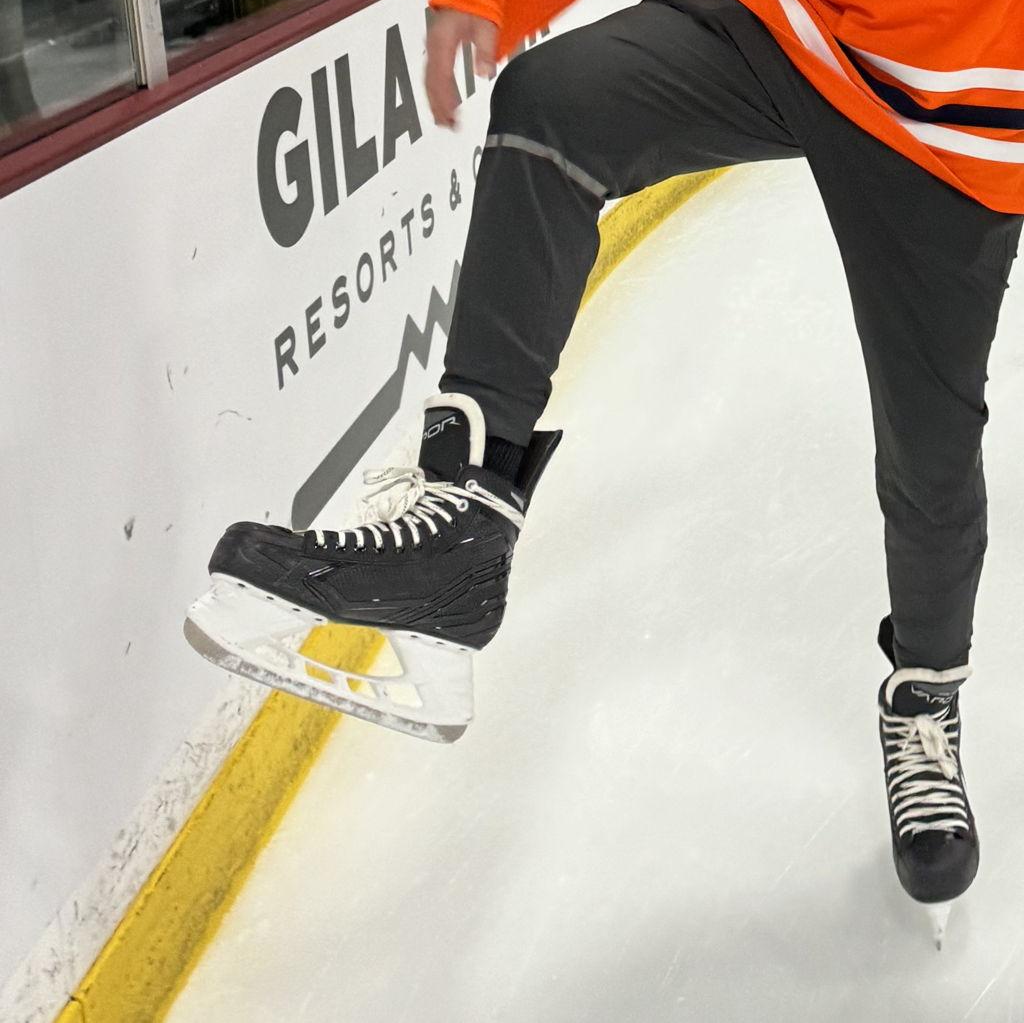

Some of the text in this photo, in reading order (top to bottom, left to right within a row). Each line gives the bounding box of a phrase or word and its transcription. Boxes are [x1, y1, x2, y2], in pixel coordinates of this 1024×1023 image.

[257, 23, 423, 248] GILA
[274, 169, 462, 390] RESORTS &
